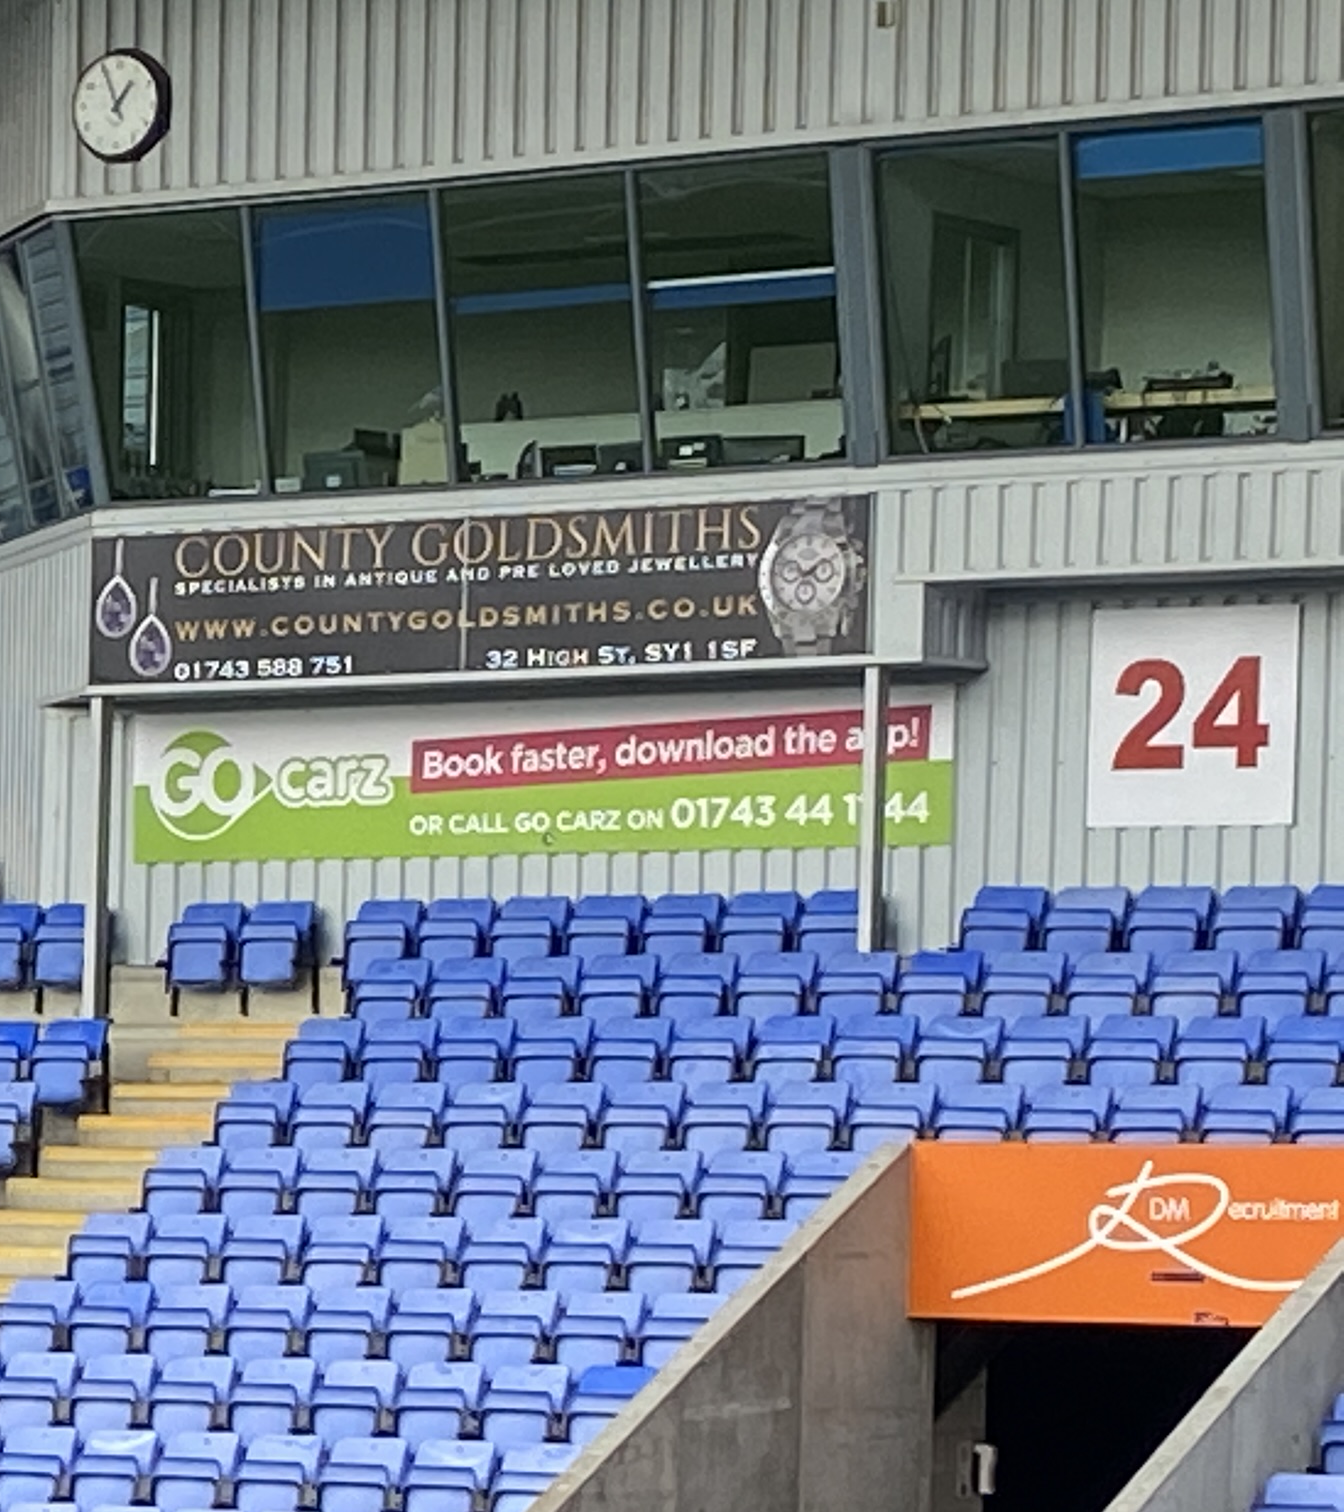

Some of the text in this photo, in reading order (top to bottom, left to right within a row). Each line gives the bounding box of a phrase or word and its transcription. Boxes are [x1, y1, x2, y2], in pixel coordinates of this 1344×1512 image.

[174, 506, 762, 578] COUNTY GOLDSMITHS
[174, 551, 760, 595] SPECIALISTS IN ANTIQUE AND PRE LOVED JEWELLERY
[175, 594, 759, 642] WWW.COUNTYGOLDSMITHS.CO.UK
[174, 654, 354, 681] 01743 588 751
[485, 649, 519, 669] 32
[644, 642, 693, 663] SY1
[708, 638, 759, 660] 1SF
[1112, 655, 1270, 770] 24
[421, 716, 921, 779] Book faster, download the ap!
[276, 753, 391, 806] carz
[409, 815, 444, 836] OR
[448, 812, 509, 836] CALL
[514, 811, 550, 835] GO
[555, 809, 619, 832] CARZ
[626, 807, 664, 831] ON
[670, 795, 777, 829] 01743
[784, 793, 835, 826] 44
[885, 790, 931, 824] 44
[1148, 1197, 1190, 1221] DM
